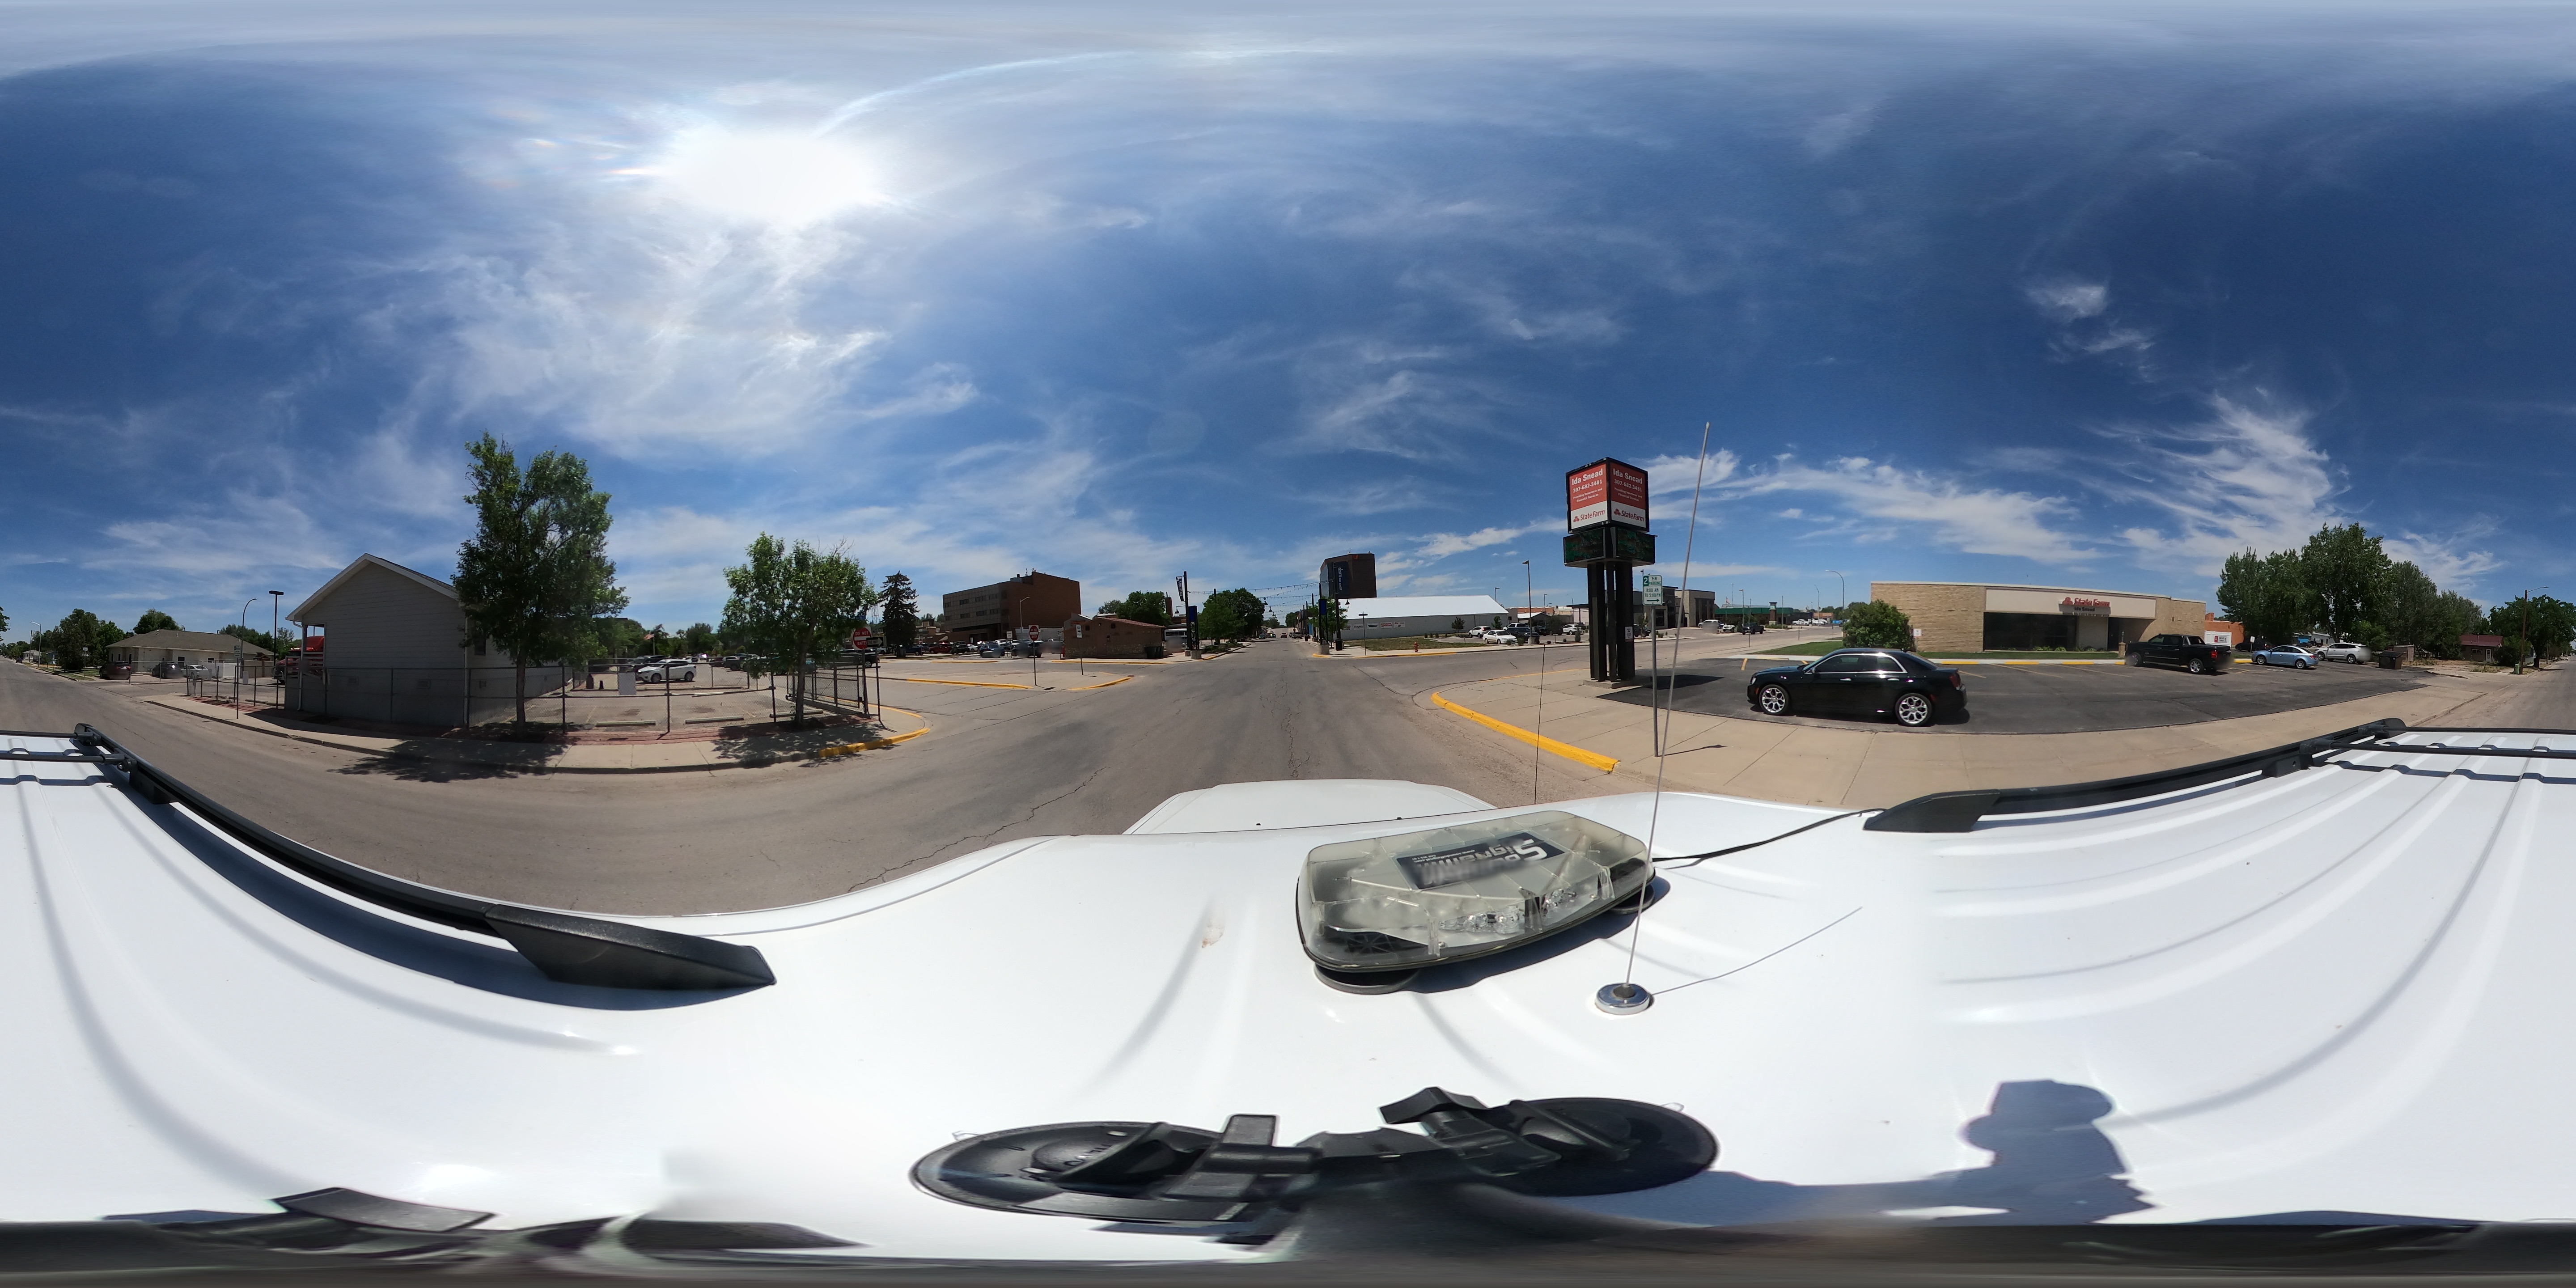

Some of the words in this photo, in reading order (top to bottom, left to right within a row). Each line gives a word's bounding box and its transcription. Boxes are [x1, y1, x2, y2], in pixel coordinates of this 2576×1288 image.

[1572, 477, 1581, 485] Ida
[1582, 468, 1603, 481] Snead
[1613, 468, 1623, 478] Ida
[1624, 472, 1643, 484] Snead
[1573, 479, 1602, 493] 307-682-3481
[1614, 479, 1642, 492] 307-682-3481
[1644, 577, 1648, 585] 2
